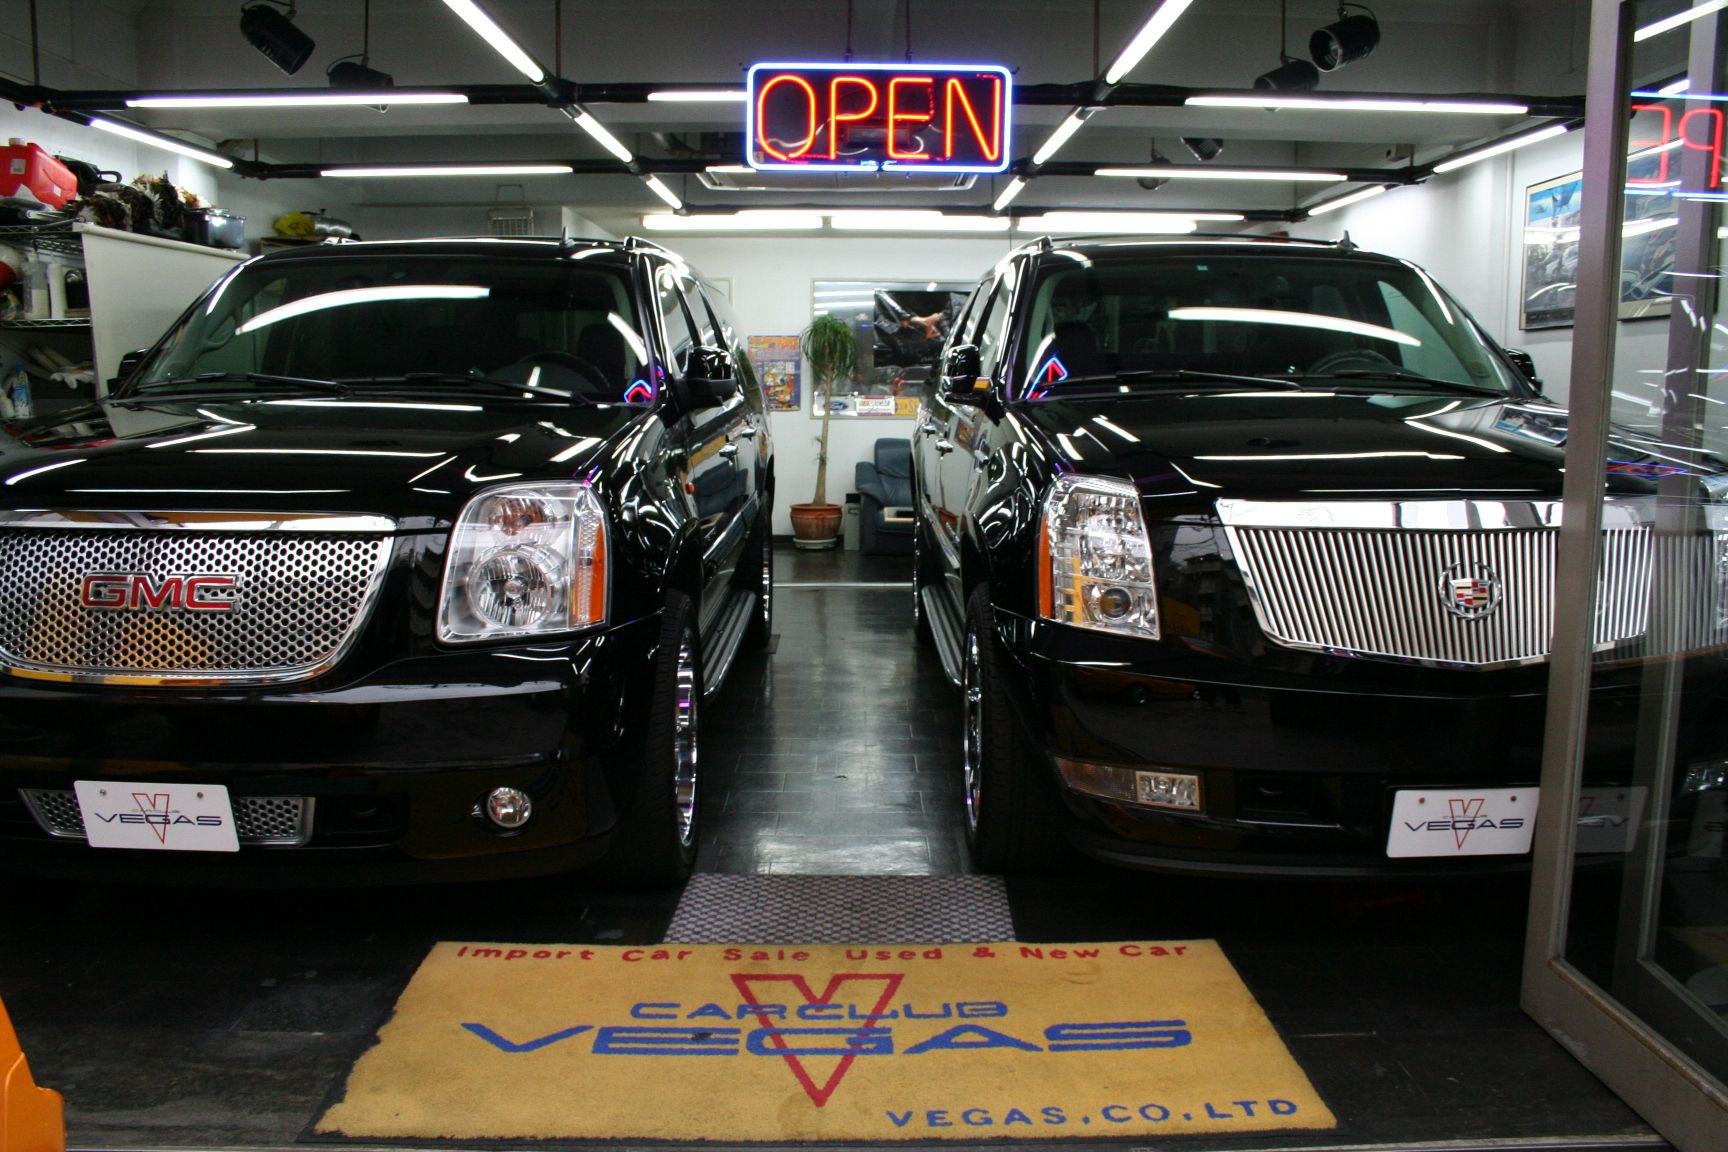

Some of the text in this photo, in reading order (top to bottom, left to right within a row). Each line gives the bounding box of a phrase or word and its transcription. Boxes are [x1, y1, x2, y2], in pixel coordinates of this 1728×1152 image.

[757, 74, 1001, 162] OPEN
[82, 573, 239, 611] GMC
[94, 812, 223, 827] VEGAS
[1404, 818, 1525, 832] VEGAS
[457, 944, 1188, 962] Import Car Sale Used & New Car
[463, 1021, 1192, 1055] VEGAS
